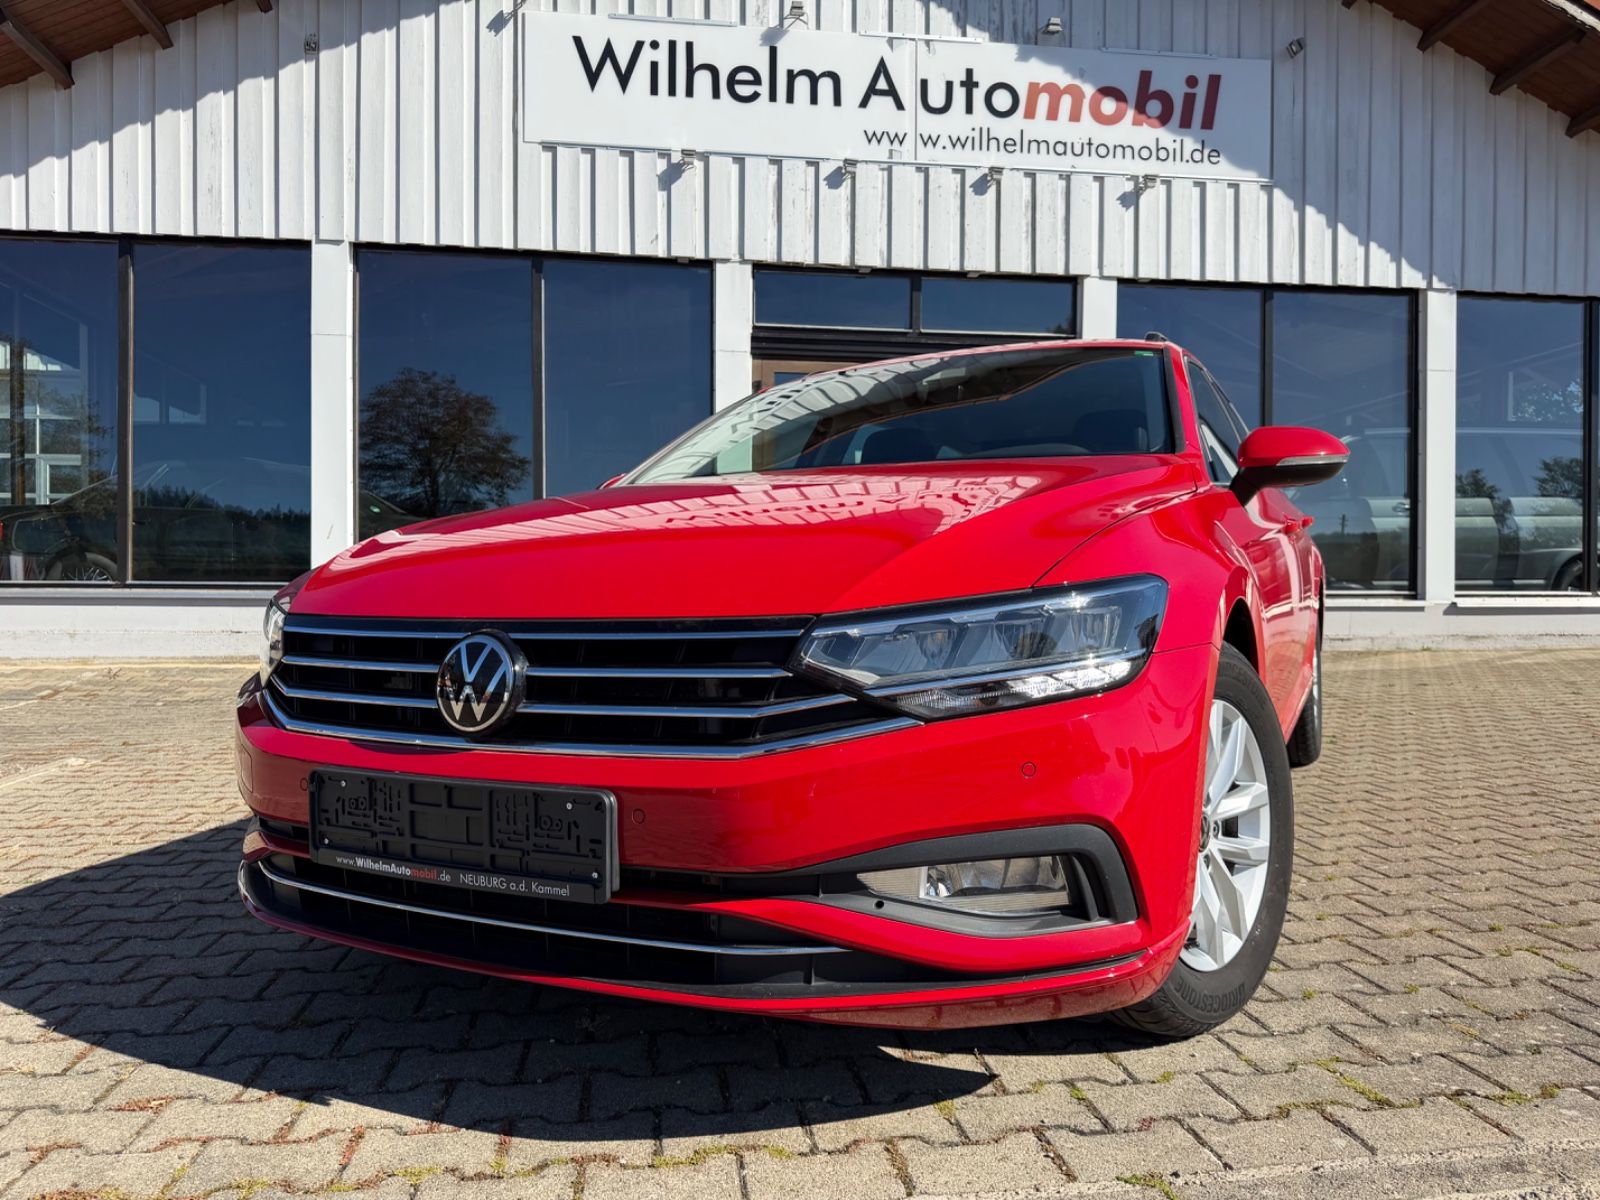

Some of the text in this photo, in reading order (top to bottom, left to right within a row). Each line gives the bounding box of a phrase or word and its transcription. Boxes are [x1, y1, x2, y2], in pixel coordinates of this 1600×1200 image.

[572, 35, 1222, 130] Wilhelm Automobil
[863, 127, 1221, 165] www.wilhelmautomobil.de
[459, 873, 507, 890] NEUBURG
[509, 880, 529, 892] a.d.
[531, 881, 570, 896] Kammel
[1174, 976, 1247, 1014] BRIDGESTONE
